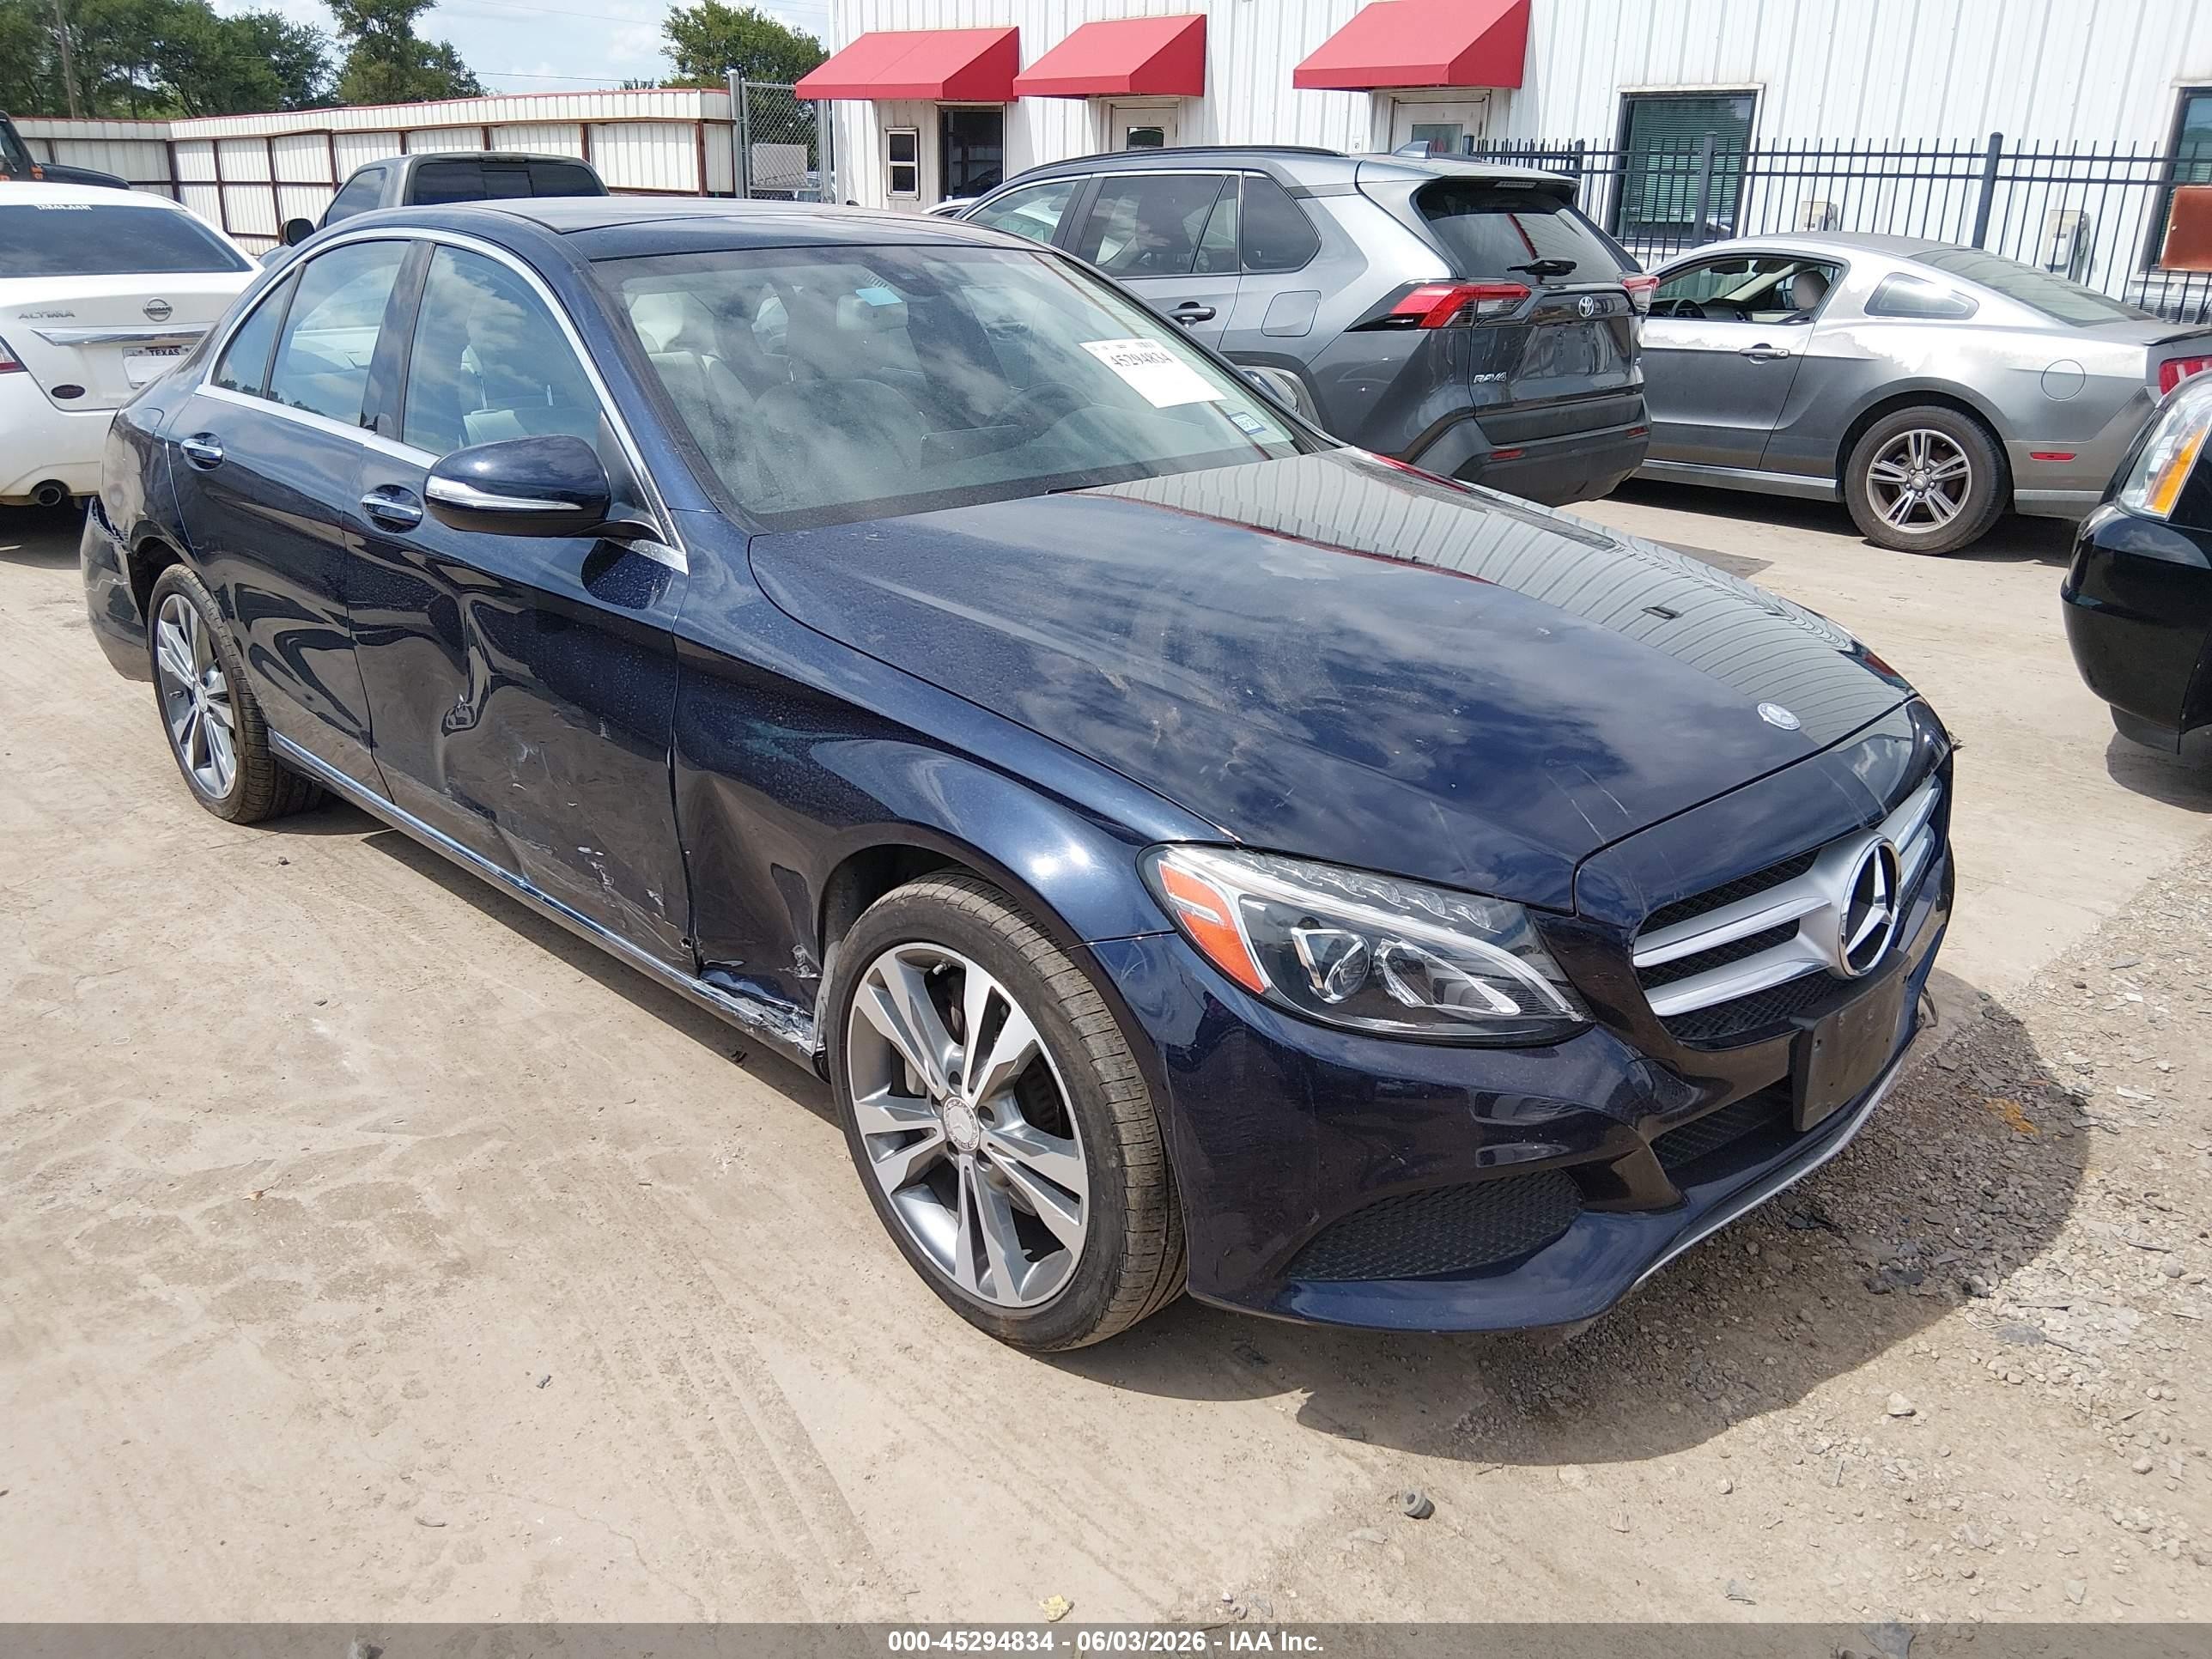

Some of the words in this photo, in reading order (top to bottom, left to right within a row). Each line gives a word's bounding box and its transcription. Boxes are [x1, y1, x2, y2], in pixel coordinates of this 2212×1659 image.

[18, 309, 76, 319] ALTIMA
[1110, 352, 1174, 367] 45294834
[1474, 372, 1507, 384] RAV4
